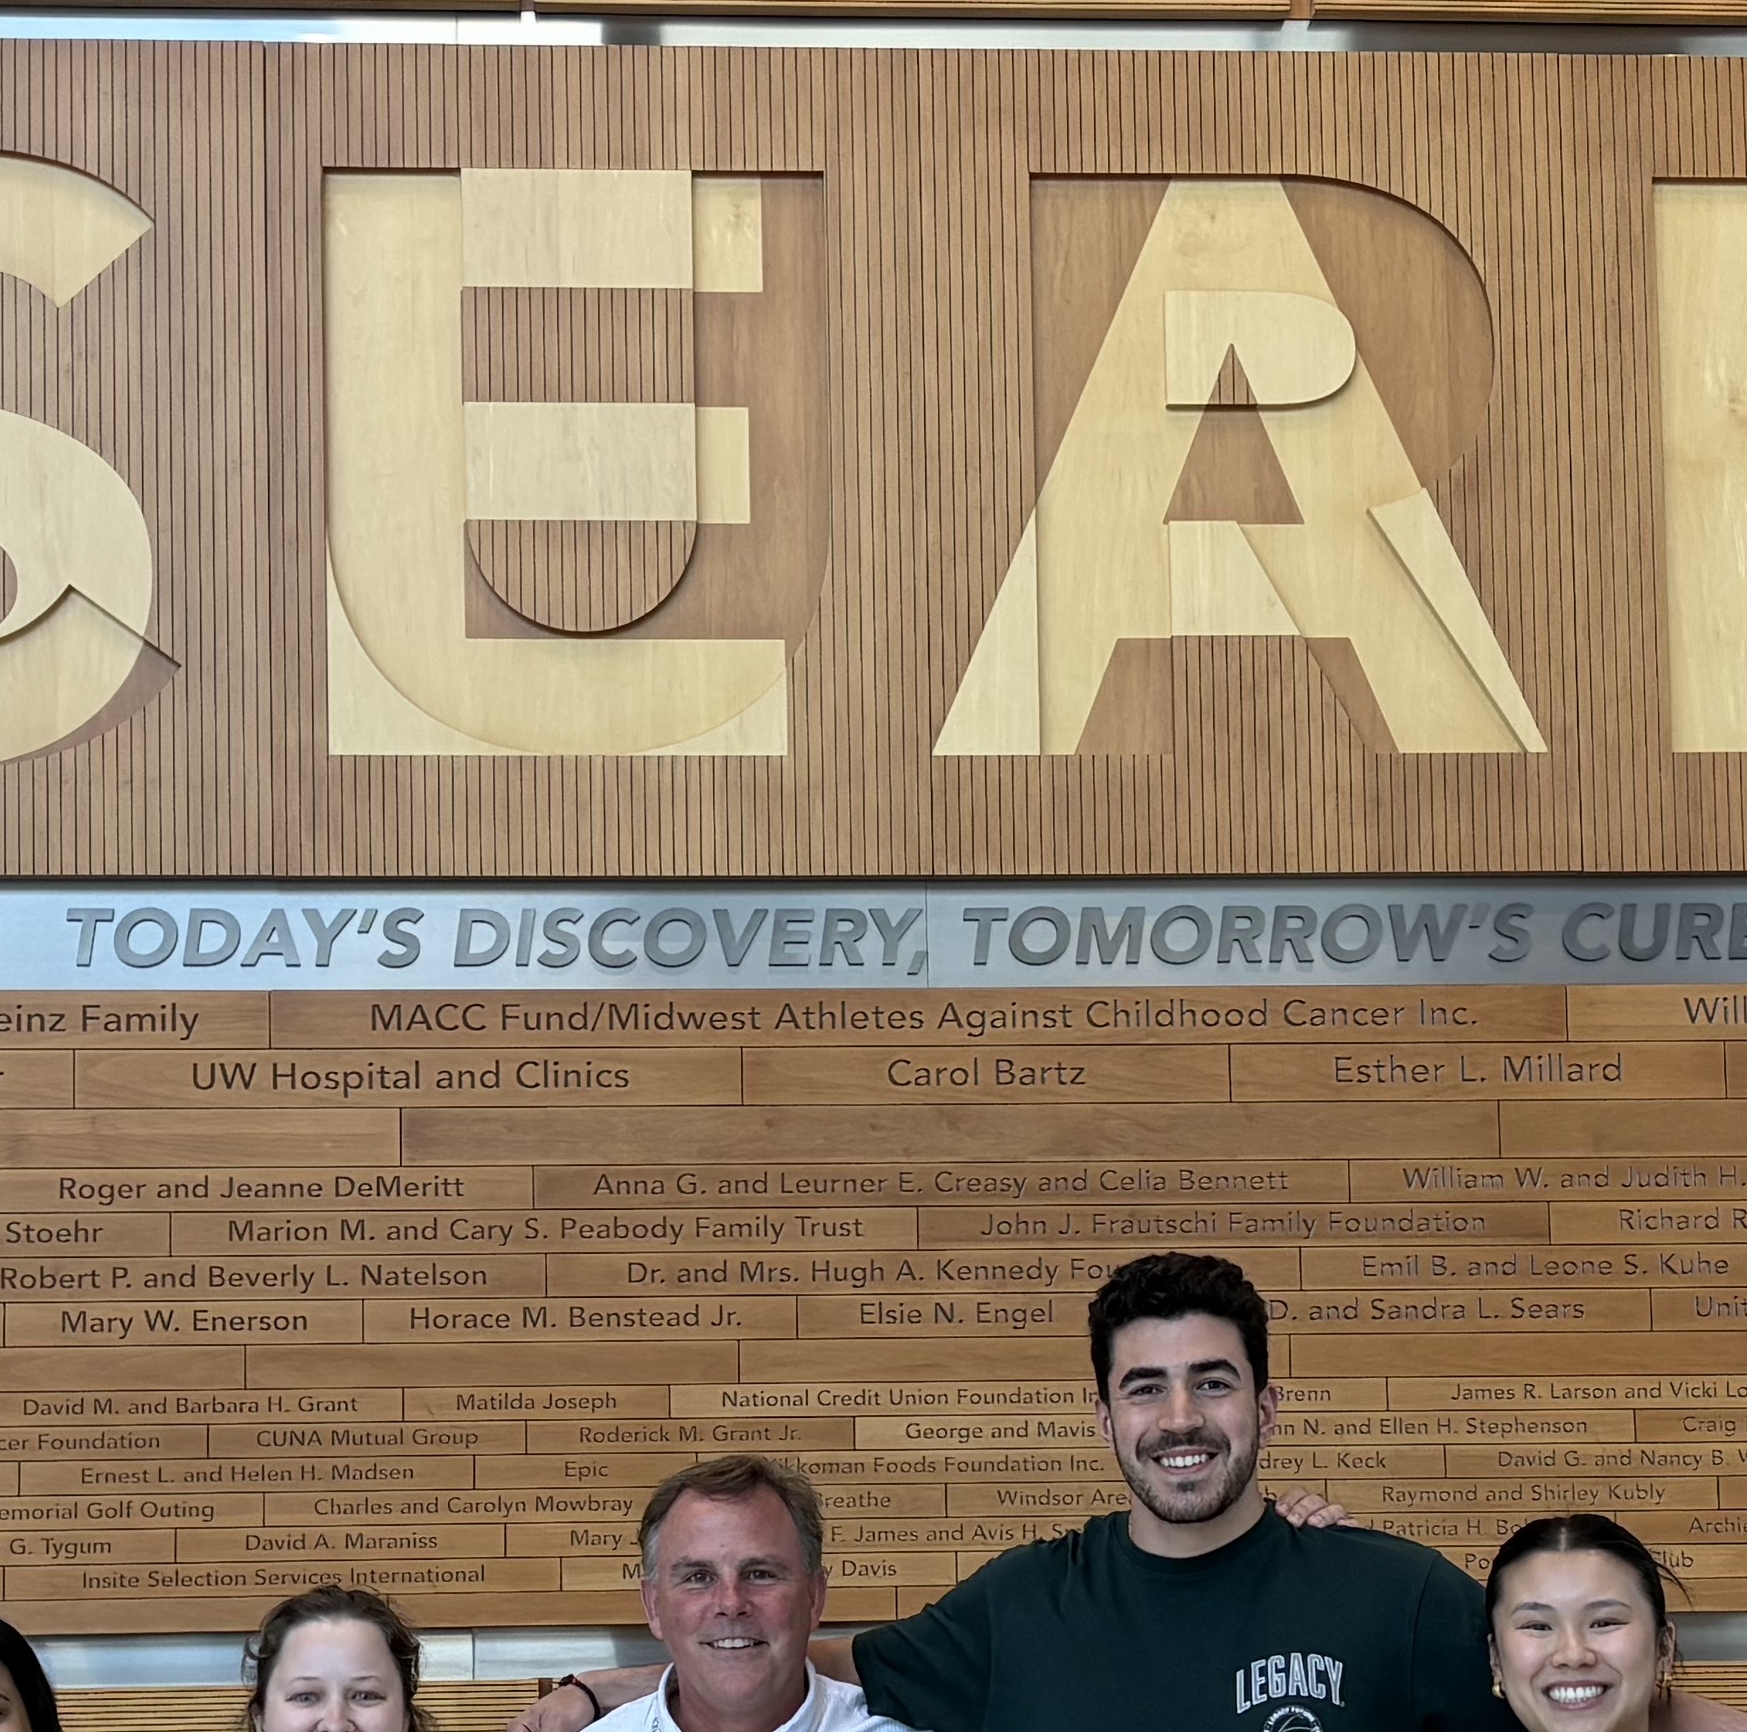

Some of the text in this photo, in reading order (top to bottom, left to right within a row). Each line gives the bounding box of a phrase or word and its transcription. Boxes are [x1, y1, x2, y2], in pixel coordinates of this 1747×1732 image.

[66, 907, 424, 969] TODAY'S
[452, 907, 927, 976] DISCOVERY,
[962, 903, 1533, 965] TOMORROW'S
[81, 1002, 200, 1041] Family
[371, 997, 1478, 1038] MACC Fund/Midwest Athletes Against Childhood Cancer Inc.
[192, 1058, 630, 1099] UW Hospital and Clinics
[887, 1056, 1087, 1087] Carol Bartz
[1334, 1051, 1622, 1084] Esther L. Millard
[59, 1174, 465, 1206] Roger and Jeanne DeMeritt
[61, 1309, 308, 1340] Mary W. Enerson
[860, 1298, 1053, 1330] Elsie N. Engel
[456, 1391, 617, 1414] Matilda Joseph
[256, 1427, 479, 1449] CUNA Mutual Group
[564, 1460, 609, 1483] Epic
[245, 1531, 438, 1551] David A. Maraniss
[1236, 1652, 1344, 1714] LEGACY
